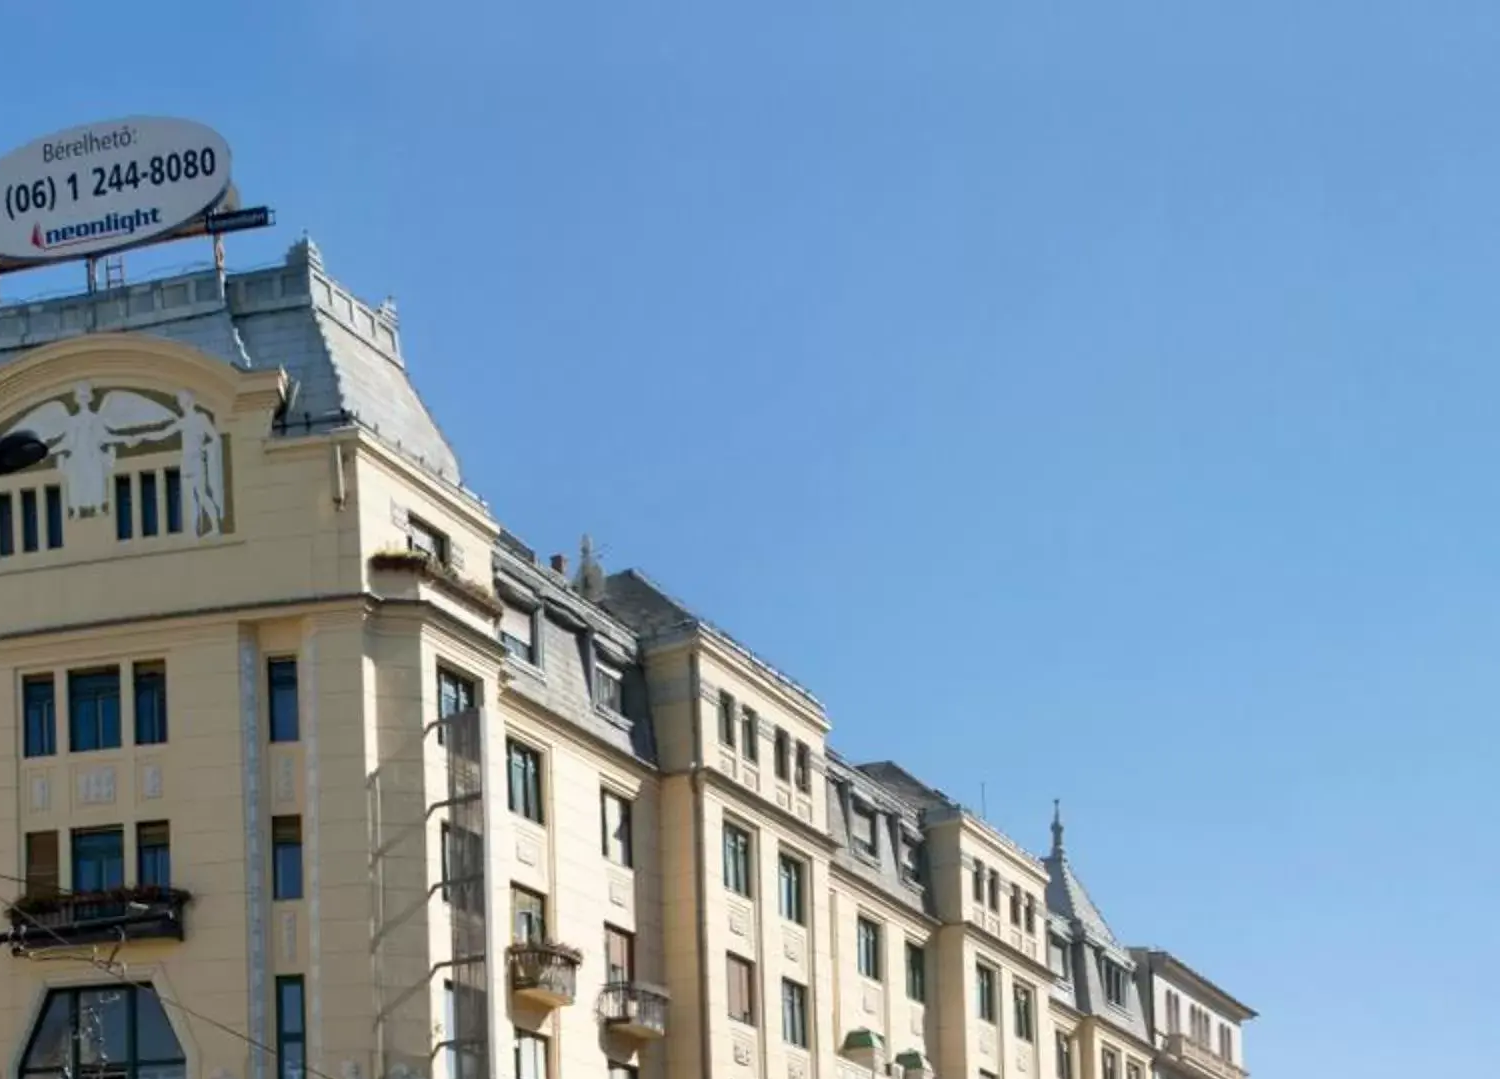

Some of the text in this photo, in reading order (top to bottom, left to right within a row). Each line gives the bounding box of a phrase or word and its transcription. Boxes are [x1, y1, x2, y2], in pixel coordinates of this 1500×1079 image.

[43, 125, 137, 163] Bérelhető:
[6, 176, 56, 220] (06)
[67, 173, 79, 201] 1
[92, 147, 216, 196] 244-8080
[45, 207, 161, 244] neonlight
